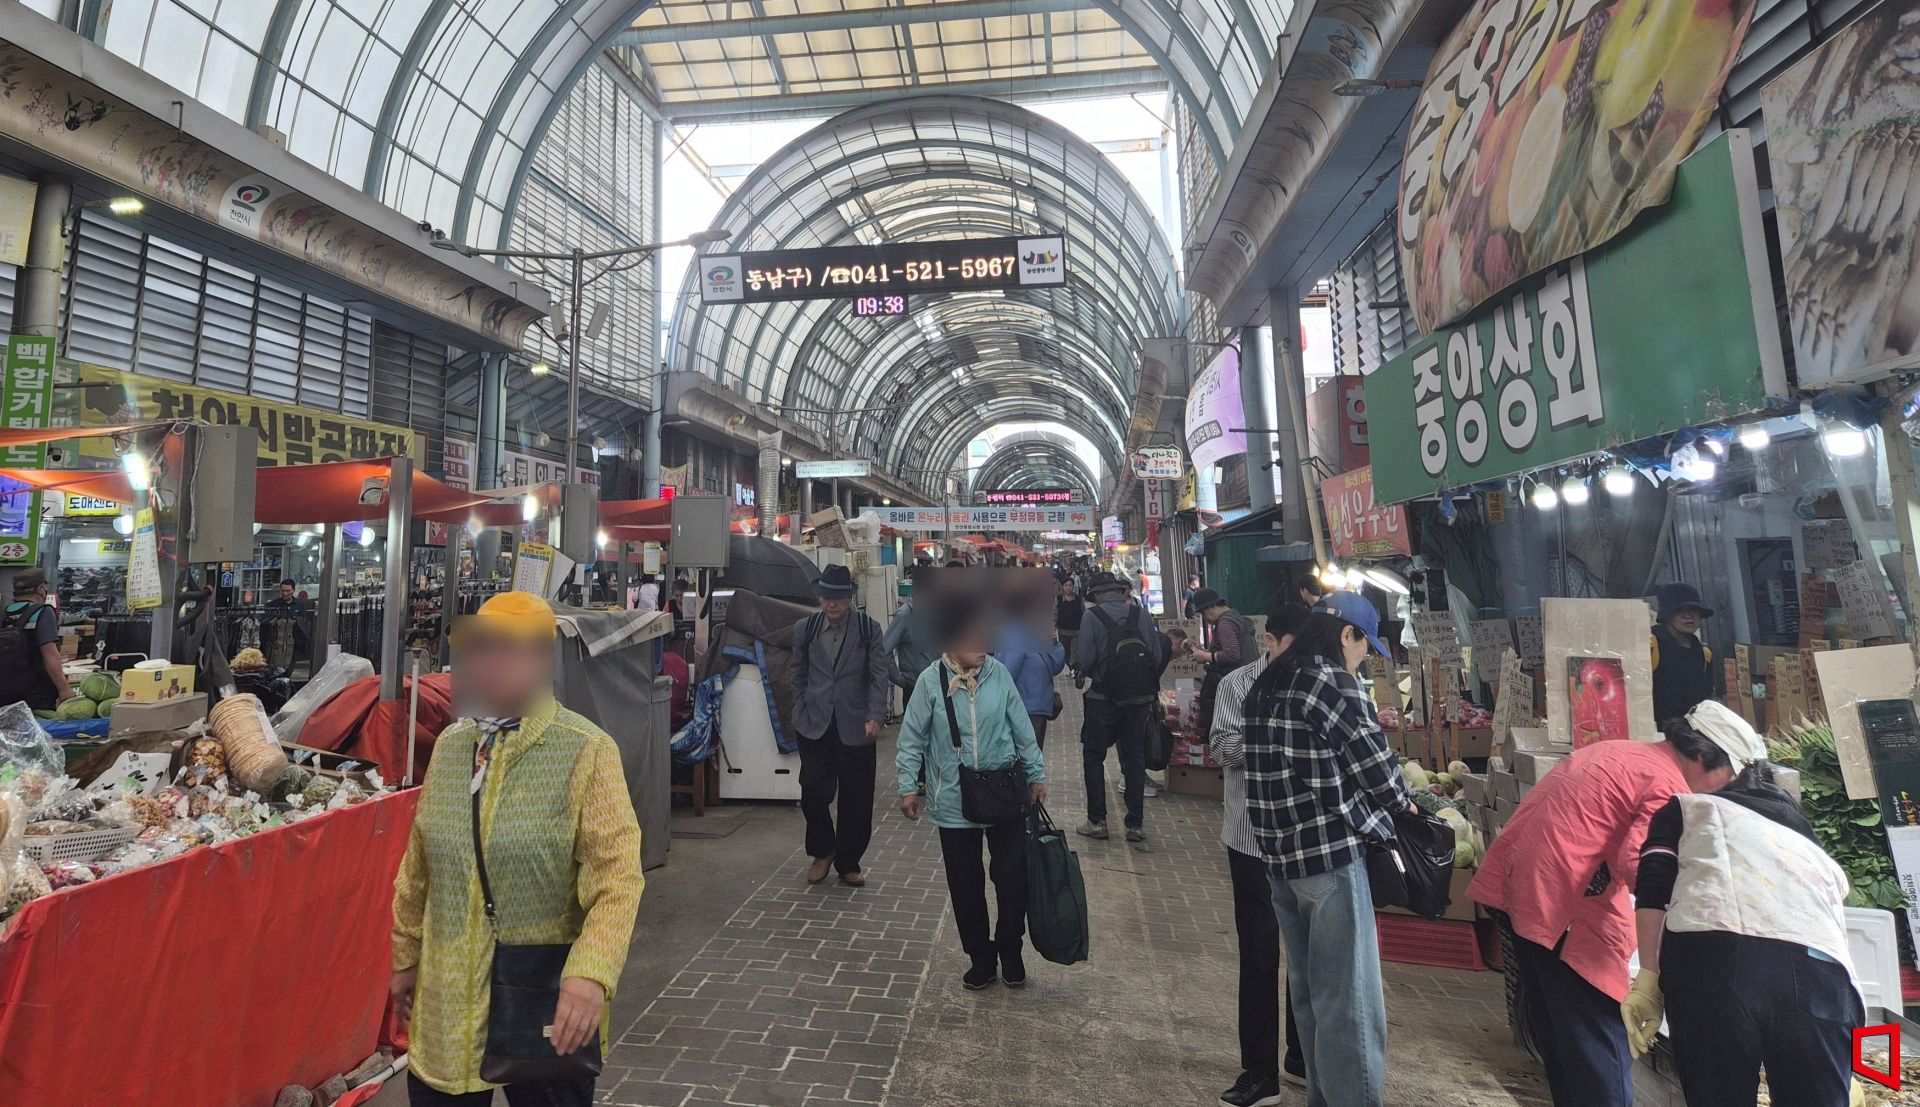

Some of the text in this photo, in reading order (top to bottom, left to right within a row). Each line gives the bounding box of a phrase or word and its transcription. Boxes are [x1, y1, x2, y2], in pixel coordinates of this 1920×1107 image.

[1402, 0, 1602, 243] 중앙
[230, 209, 251, 227] 천안시
[745, 266, 812, 291] 동남구)
[857, 296, 904, 315] 09:38
[1413, 255, 1604, 476] 중앙상회
[889, 511, 915, 523] 올바른
[972, 511, 1007, 523] 사용으로
[1010, 511, 1045, 523] 부정유통
[1047, 511, 1065, 523] 근절
[2, 543, 25, 558] 2층
